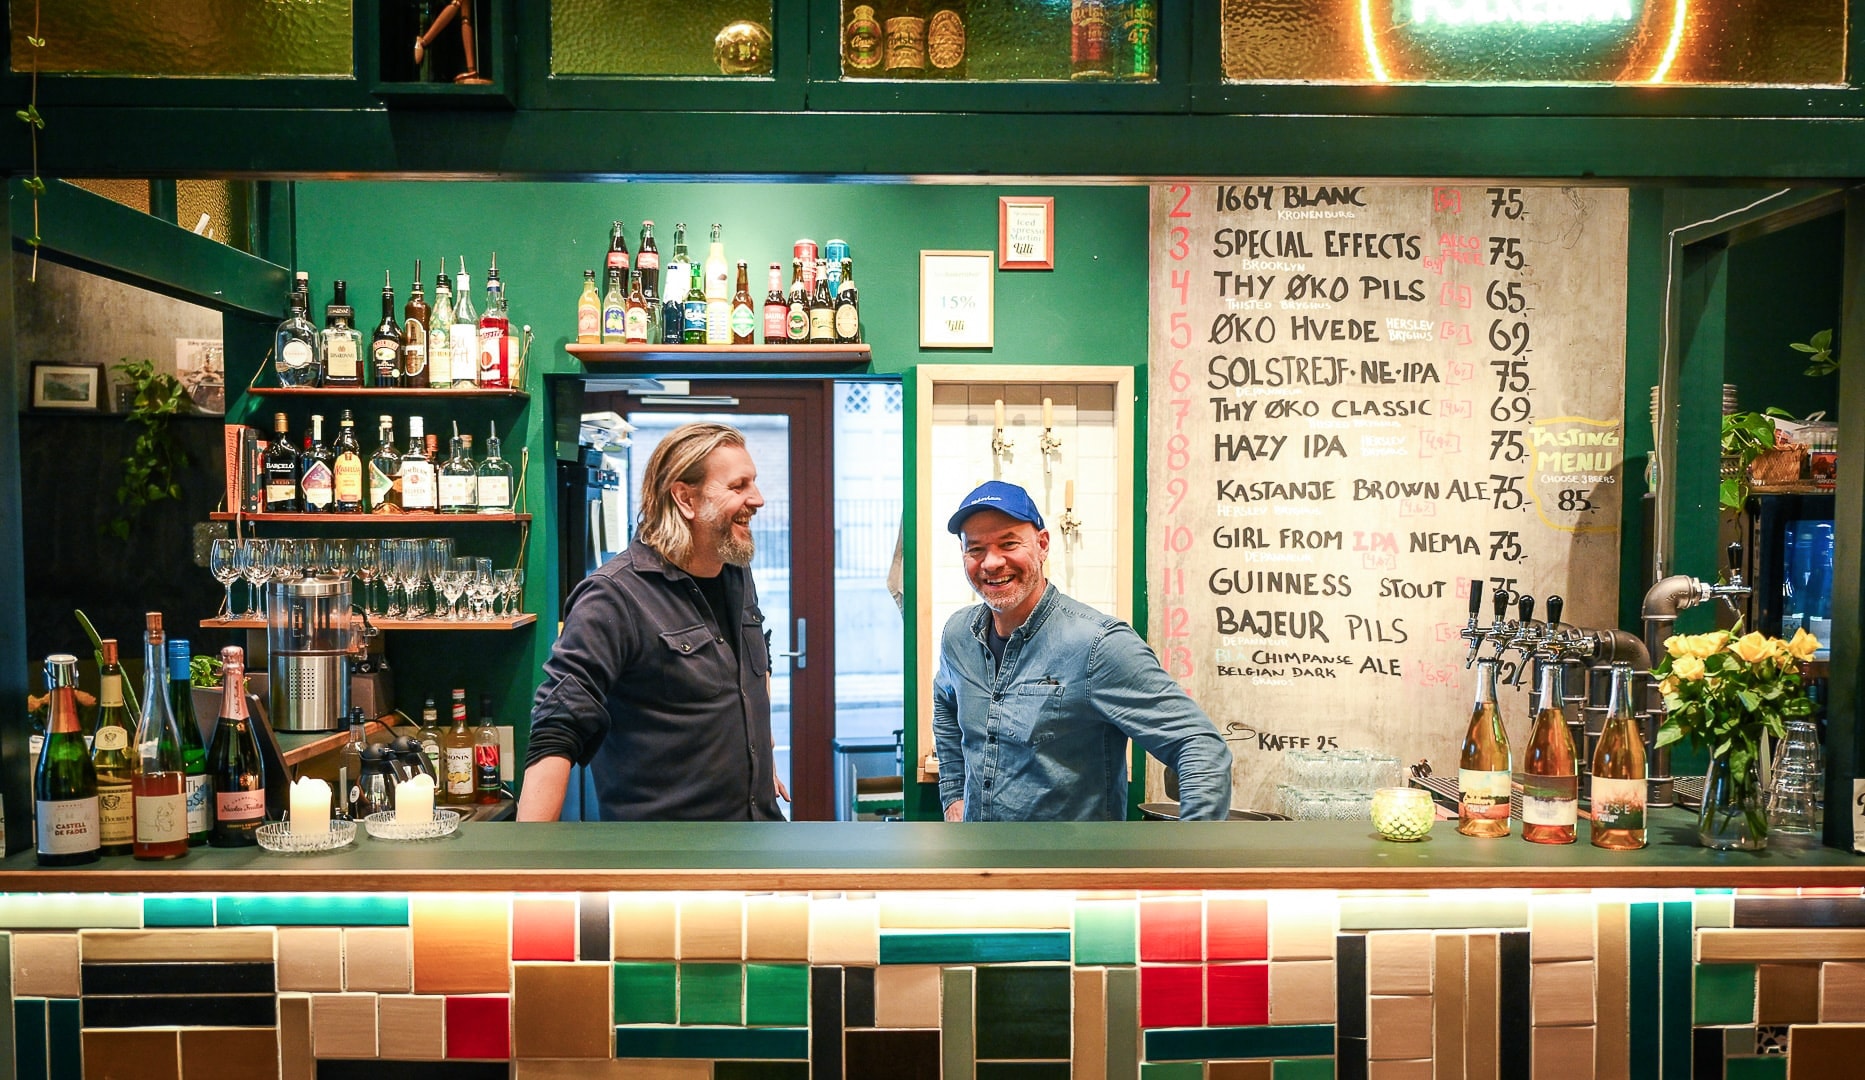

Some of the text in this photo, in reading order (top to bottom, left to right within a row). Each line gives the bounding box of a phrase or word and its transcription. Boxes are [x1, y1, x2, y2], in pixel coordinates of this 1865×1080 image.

[1169, 184, 1192, 218] 2
[1217, 186, 1274, 212] 1664
[1283, 186, 1367, 209] BLANC
[1016, 219, 1036, 227] Iced
[1169, 226, 1190, 261] 3
[1213, 228, 1313, 259] SPECIAL
[1325, 232, 1421, 260] EFFECTS
[1242, 258, 1306, 272] BROOKLYN
[941, 295, 977, 310] 15%
[1171, 269, 1190, 305] 4
[1213, 270, 1276, 300] THY
[1284, 274, 1349, 303] ØKO
[1359, 276, 1426, 302] PILS
[1170, 312, 1192, 349] 5
[1208, 313, 1276, 344] ØKO
[1291, 315, 1380, 343] HVEDE
[1386, 317, 1434, 331] HERSLEV
[1169, 359, 1191, 392] 6
[1169, 400, 1191, 430] 7
[1210, 397, 1258, 422] THY
[1265, 398, 1320, 419] ØKO
[1332, 399, 1432, 418] CLASSIC
[1167, 433, 1190, 471] 8
[1214, 433, 1288, 462] HAZY
[1304, 433, 1348, 459] IPA
[1528, 426, 1619, 447] TASTING
[1537, 451, 1612, 473] MENU
[1541, 474, 1579, 484] CHOOSE
[1167, 478, 1189, 515] 9
[1217, 479, 1336, 502] KASTANJE
[1353, 478, 1440, 501] BROWN
[1445, 479, 1490, 502] ALE
[1164, 525, 1194, 553] 10
[1213, 526, 1271, 549] GIRL
[1280, 528, 1343, 550] FROM
[1353, 530, 1399, 554] IPA
[1409, 531, 1481, 556] NEMA
[1164, 567, 1185, 595] 11
[1209, 567, 1352, 597] GUINNESS
[1379, 577, 1447, 599] STOUT
[1164, 606, 1191, 640] 12
[1216, 606, 1330, 644] BAJEUR
[1345, 614, 1408, 644] PILS
[1162, 646, 1194, 679] 13
[1252, 650, 1354, 665] CHIMPANSE
[1217, 665, 1336, 678] BELGIAN DARK
[1359, 656, 1402, 677] ALE
[55, 822, 87, 830] CASTELL
